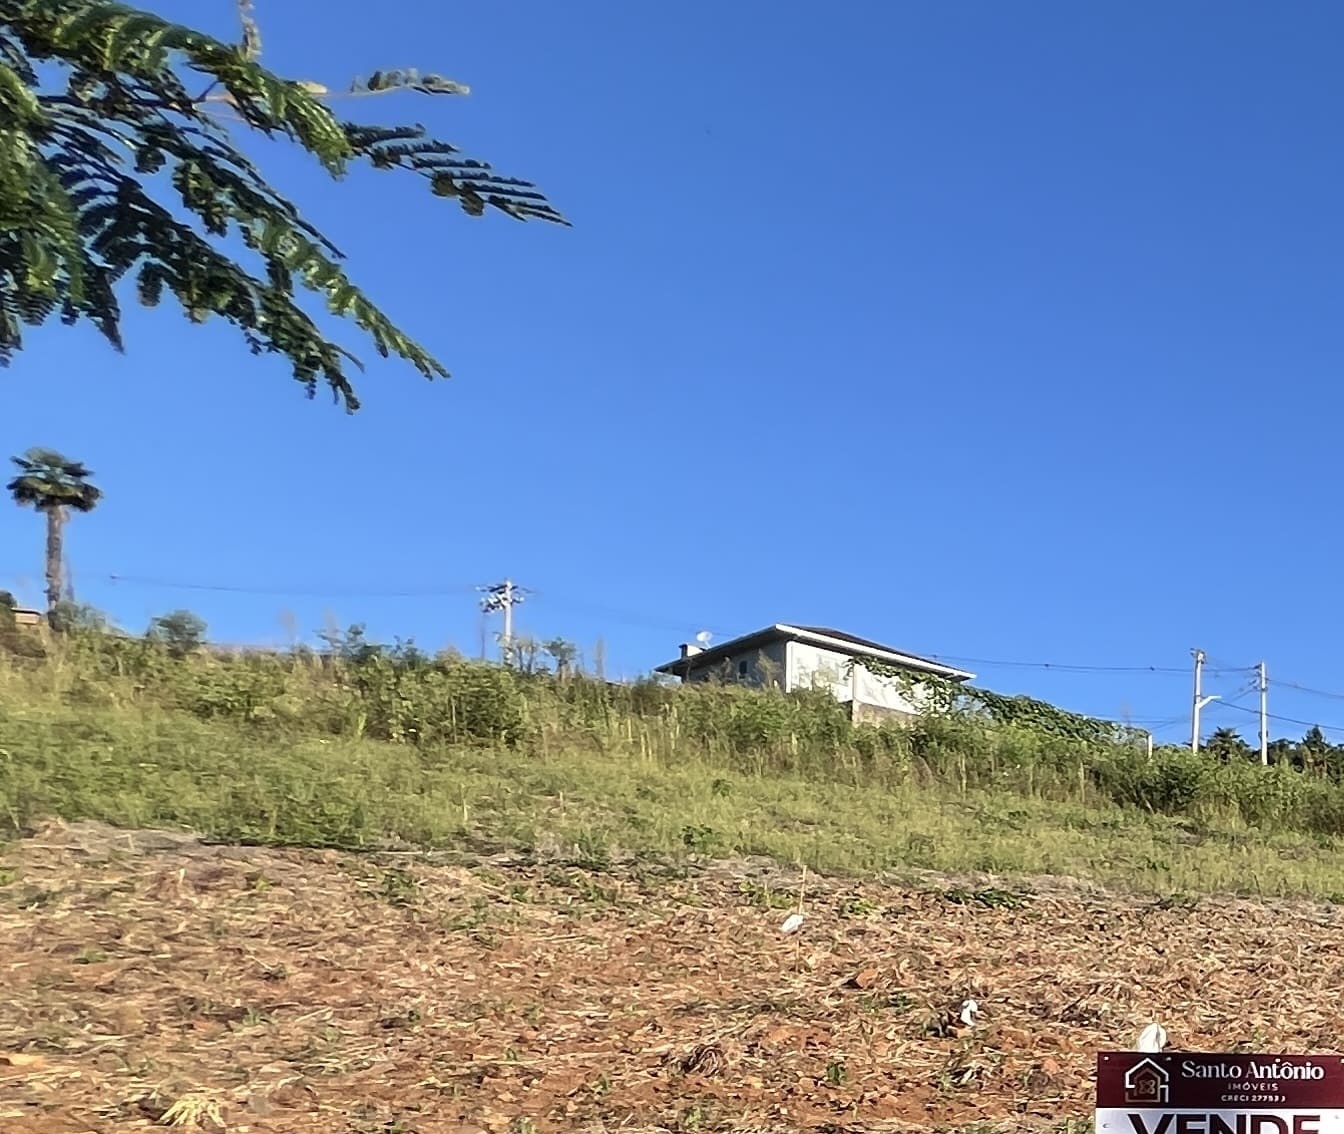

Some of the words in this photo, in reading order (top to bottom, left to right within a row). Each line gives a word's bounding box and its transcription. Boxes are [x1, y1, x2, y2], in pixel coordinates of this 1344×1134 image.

[1181, 1060, 1243, 1079] Santo
[1245, 1061, 1325, 1080] Antônio
[1228, 1082, 1279, 1092] IMÓVEIS
[1221, 1094, 1249, 1102] CRECI
